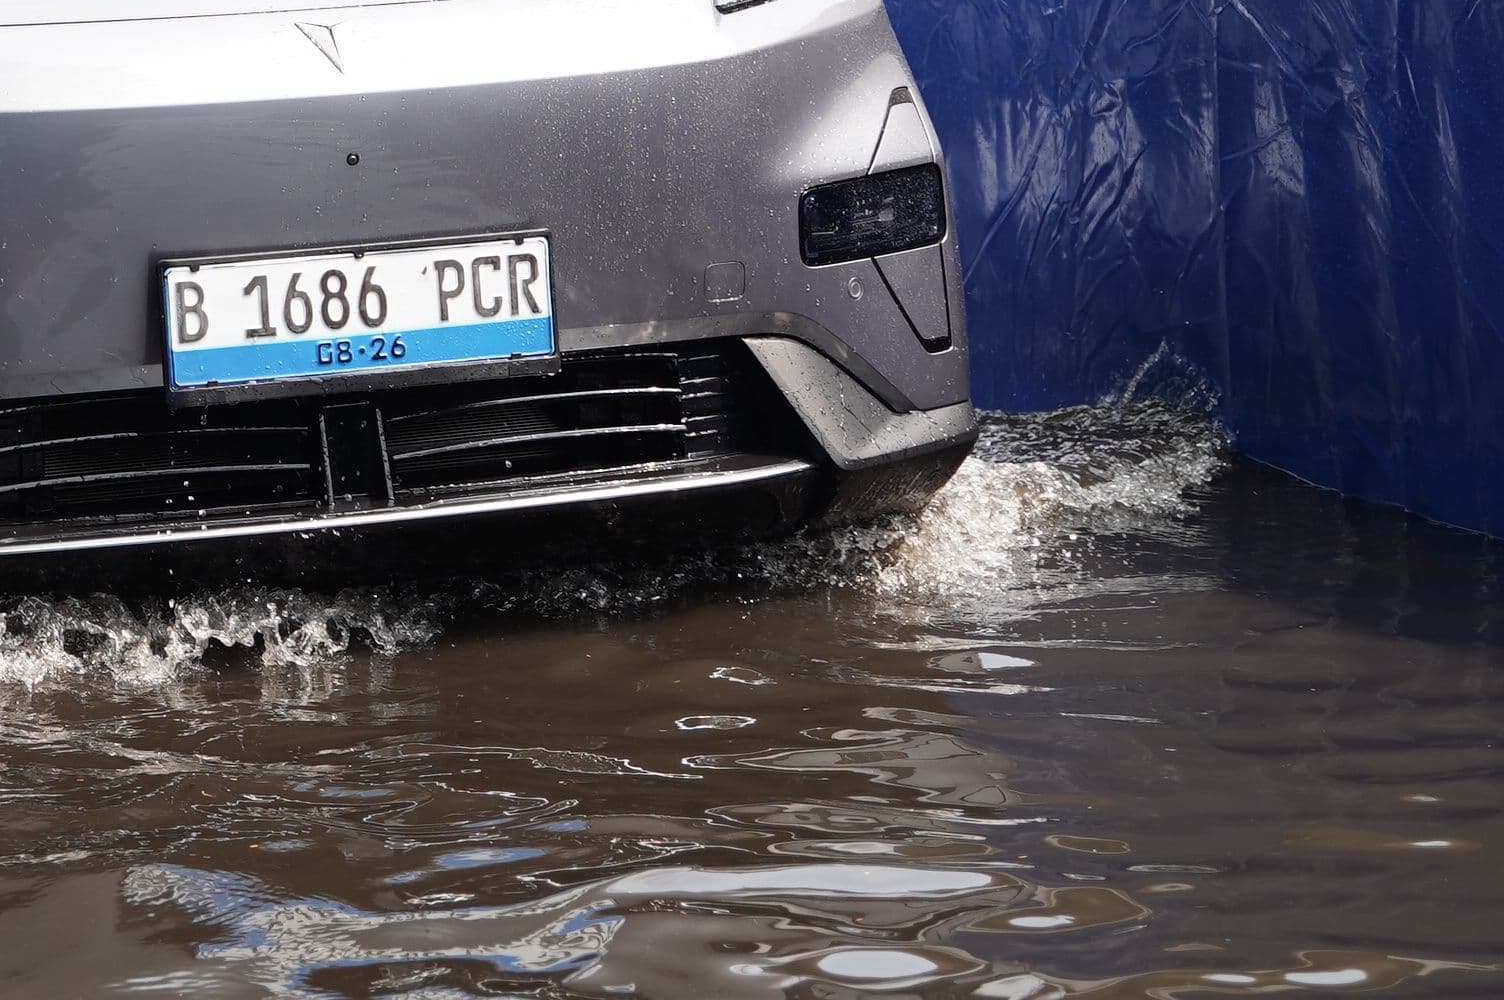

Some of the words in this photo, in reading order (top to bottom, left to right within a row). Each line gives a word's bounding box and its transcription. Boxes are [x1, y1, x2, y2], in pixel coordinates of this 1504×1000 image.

[174, 280, 210, 345] B
[242, 265, 389, 340] 1686
[433, 252, 543, 322] PCR
